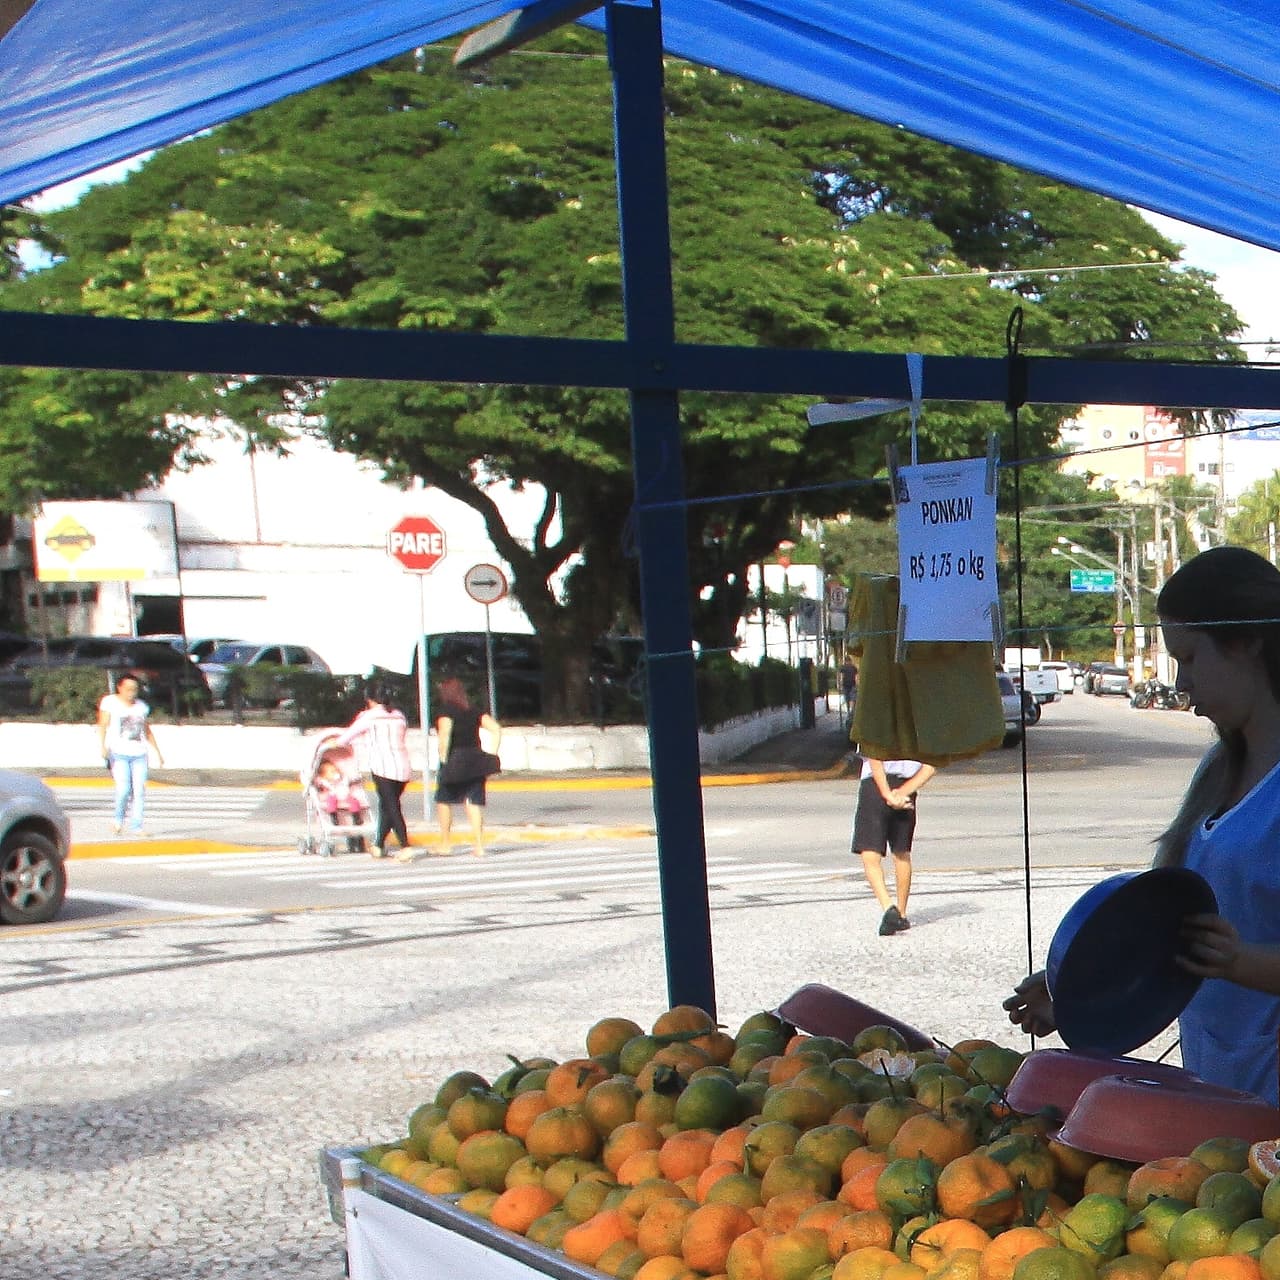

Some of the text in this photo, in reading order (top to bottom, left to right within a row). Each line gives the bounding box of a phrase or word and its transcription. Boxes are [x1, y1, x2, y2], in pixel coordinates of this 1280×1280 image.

[921, 496, 972, 525] PONKAN
[390, 531, 442, 555] PARE
[911, 550, 984, 583] R$ 1,75 o kg
